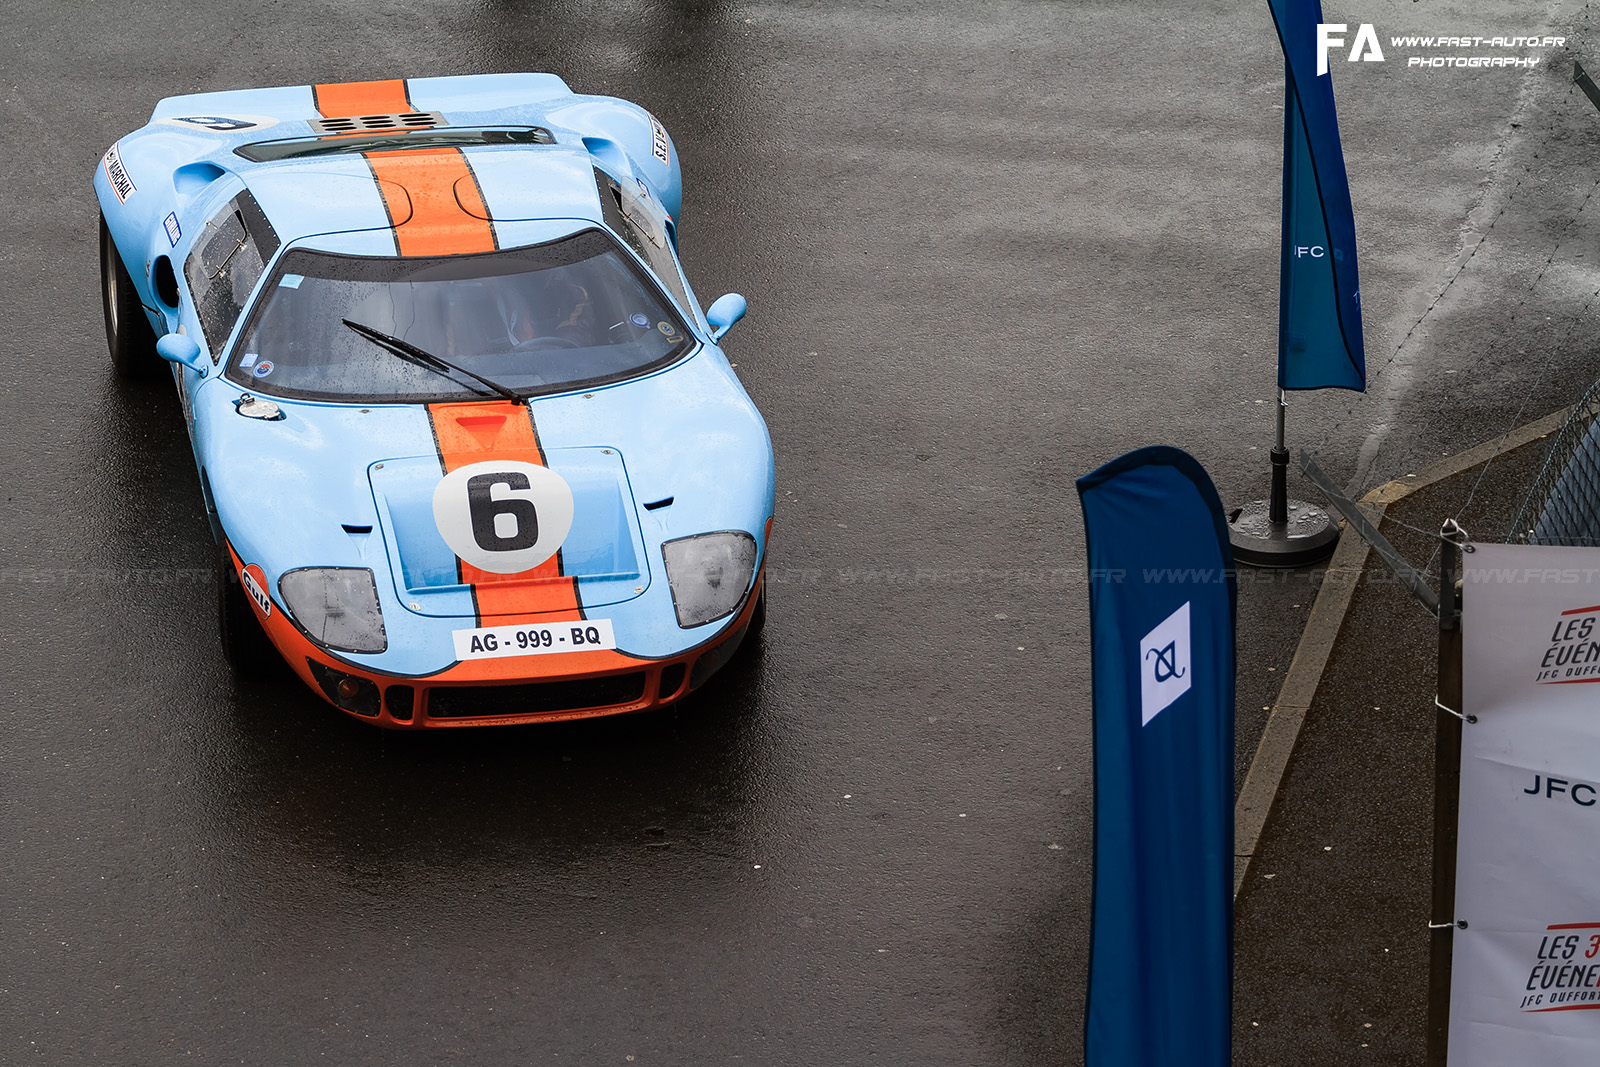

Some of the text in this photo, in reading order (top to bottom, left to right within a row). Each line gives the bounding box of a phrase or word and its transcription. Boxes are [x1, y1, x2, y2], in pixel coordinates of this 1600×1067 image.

[108, 159, 132, 199] MARCHAL
[467, 472, 539, 552] 6
[243, 571, 270, 613] Gulf
[470, 633, 499, 653] AG
[516, 629, 553, 649] 999
[570, 626, 601, 645] BQ
[1551, 617, 1596, 642] LES
[1536, 669, 1559, 681] JFC
[1524, 774, 1596, 806] JFC
[1537, 935, 1579, 959] LES
[1526, 960, 1600, 991] ÉVÉNE
[1520, 994, 1543, 1008] JFC
